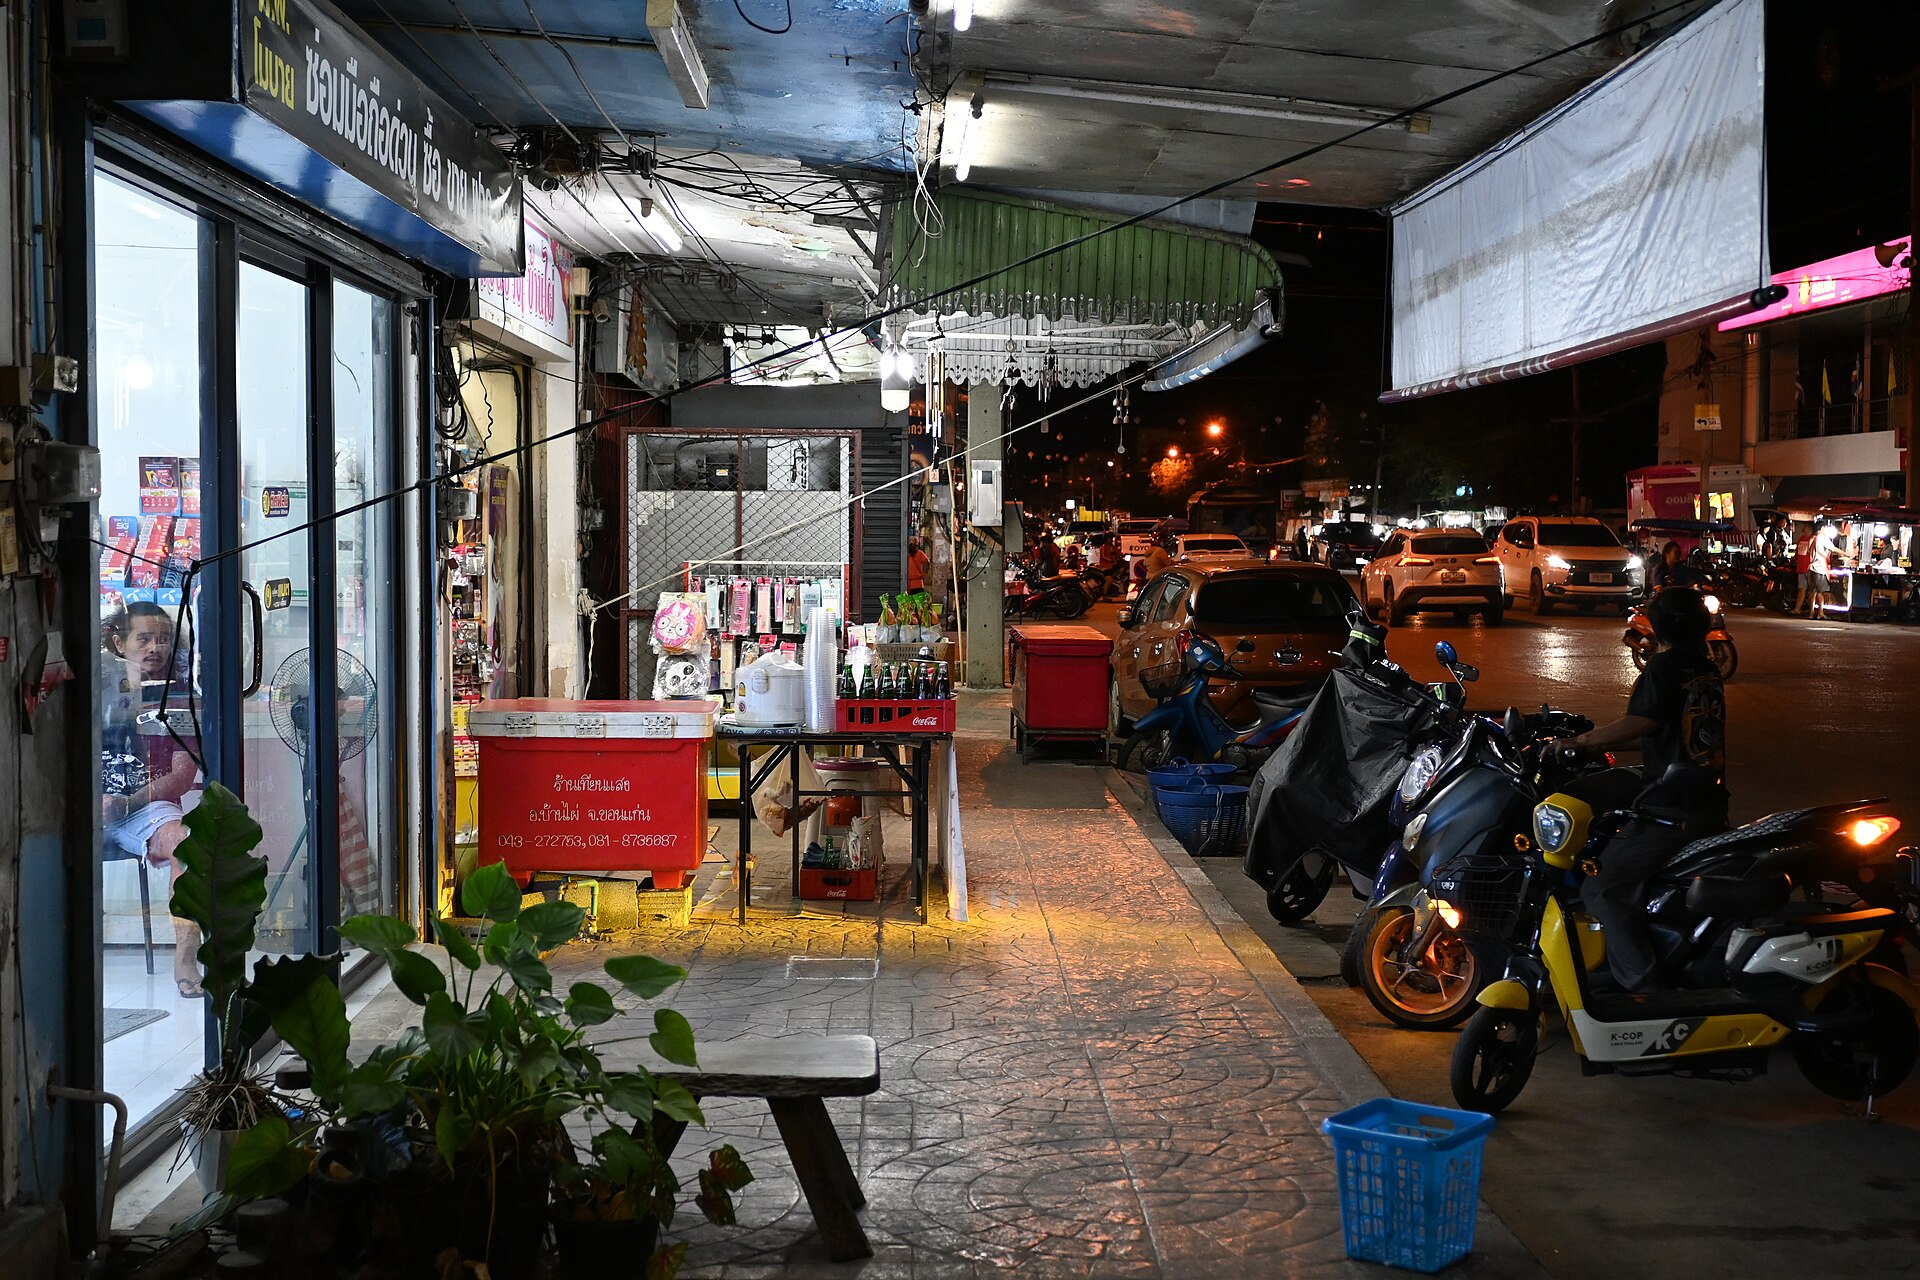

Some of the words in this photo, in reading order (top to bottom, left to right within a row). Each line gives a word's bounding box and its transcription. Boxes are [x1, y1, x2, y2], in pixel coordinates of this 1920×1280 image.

[253, 15, 295, 111] โมบาย
[422, 106, 442, 203] ซื้อ
[1129, 544, 1150, 552] TOYO
[553, 773, 630, 792] ร้านเทียนแสง
[528, 800, 580, 822] อ.บ้านไผ่
[587, 804, 651, 822] จ.ขอนแก่น
[1611, 1031, 1644, 1041] K-COP
